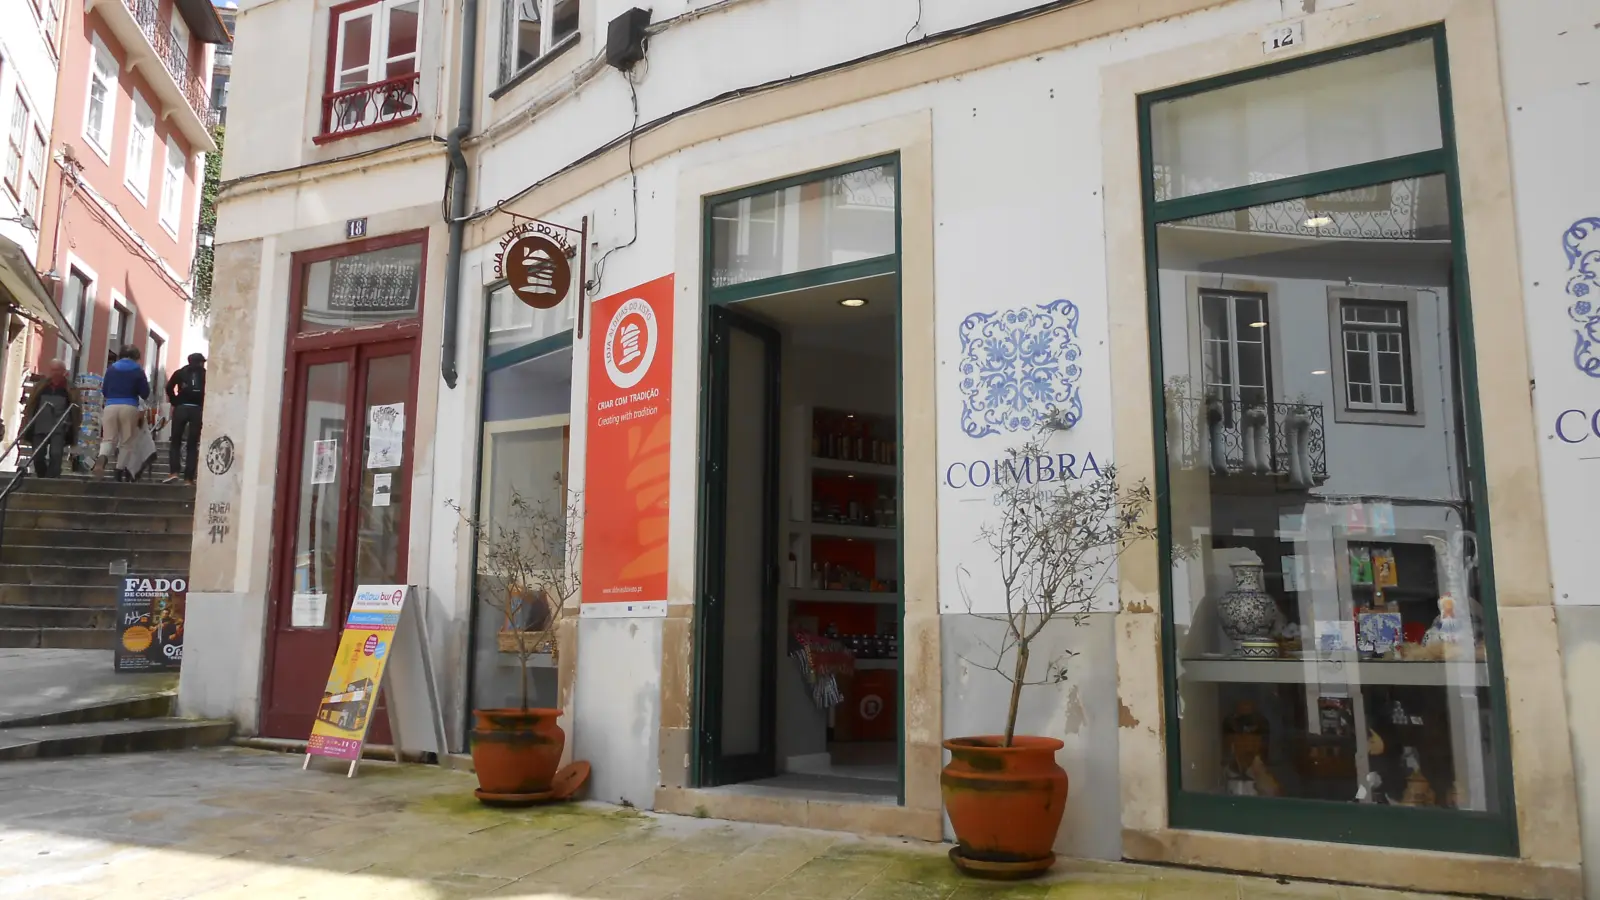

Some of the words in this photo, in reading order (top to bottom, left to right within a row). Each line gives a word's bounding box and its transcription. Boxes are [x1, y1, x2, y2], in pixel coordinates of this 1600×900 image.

[1273, 27, 1294, 49] 12
[350, 220, 362, 236] 18
[493, 252, 504, 279] LOJA
[499, 222, 535, 251] ALDEIAS
[537, 223, 552, 235] DO
[597, 399, 614, 411] CRIAR
[614, 396, 628, 407] COM
[629, 387, 659, 402] TRADIÇÃO
[597, 415, 620, 427] Creating
[620, 410, 633, 422] with
[633, 406, 658, 419] tradition
[946, 451, 1102, 489] COIMBRA
[124, 578, 187, 592] FADO
